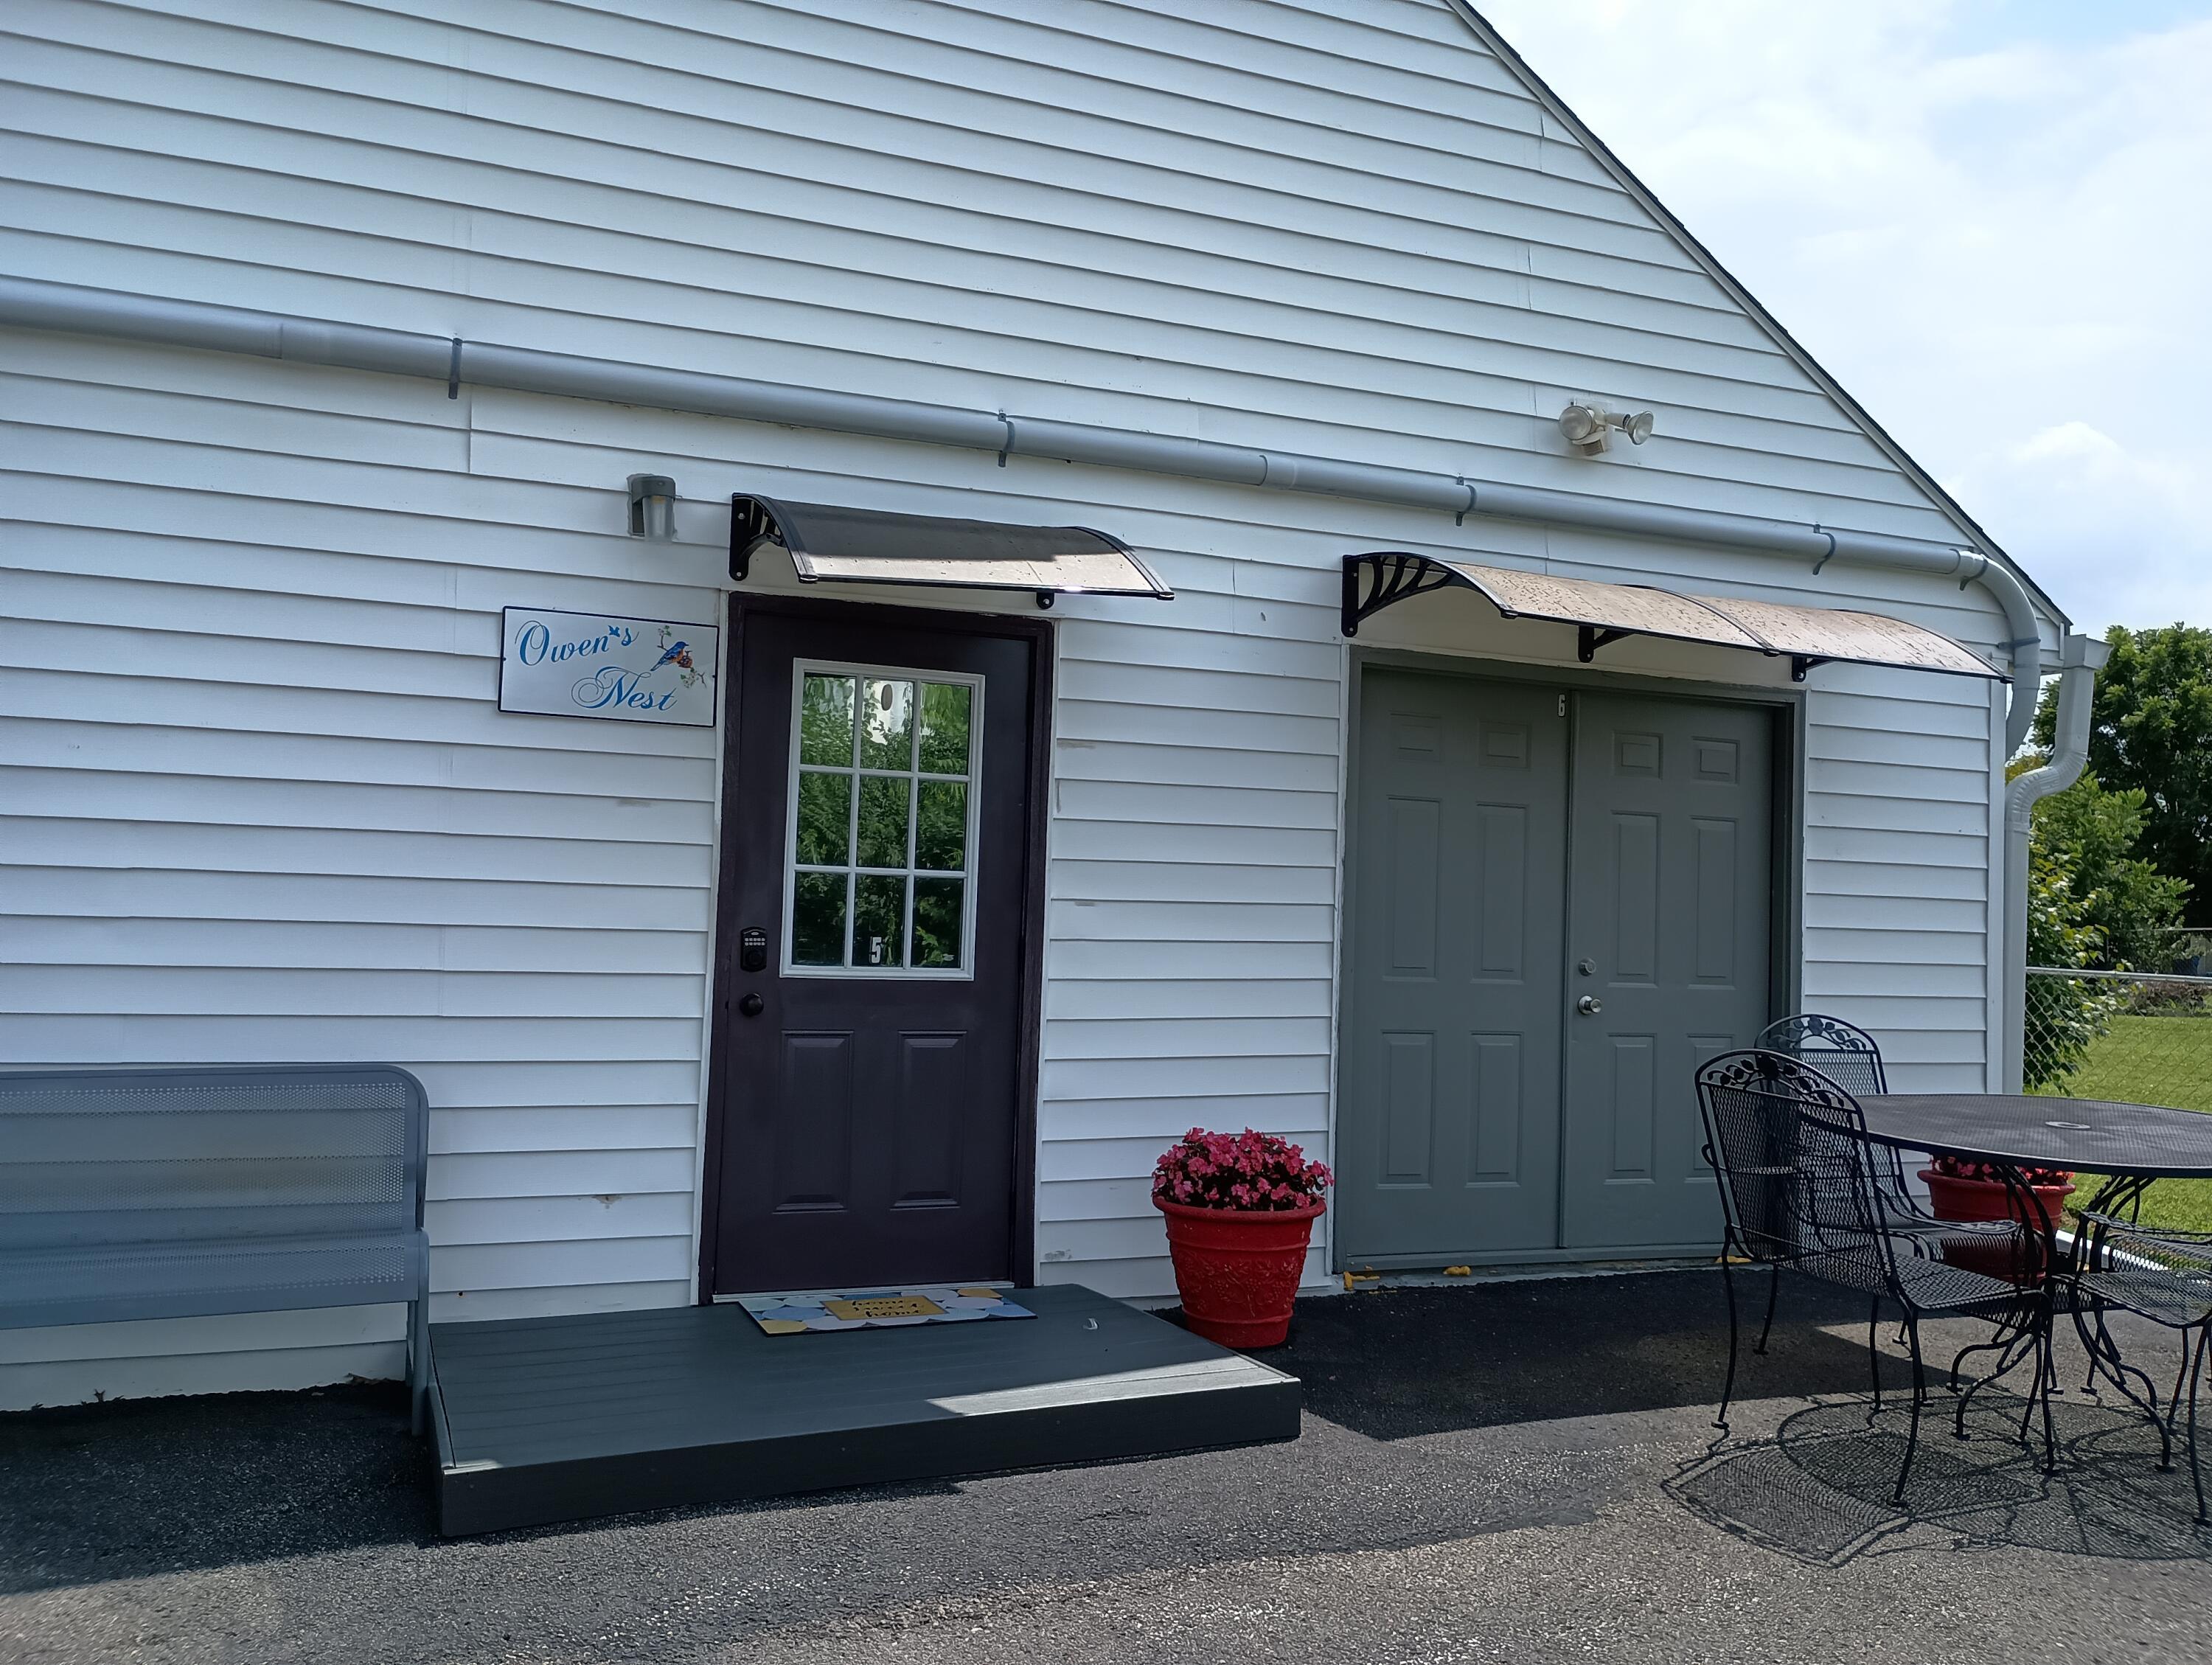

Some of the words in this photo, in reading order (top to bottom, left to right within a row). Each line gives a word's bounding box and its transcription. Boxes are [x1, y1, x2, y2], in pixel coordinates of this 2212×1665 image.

[571, 666, 678, 711] Nest
[1558, 694, 1565, 717] 6
[871, 936, 882, 964] 5
